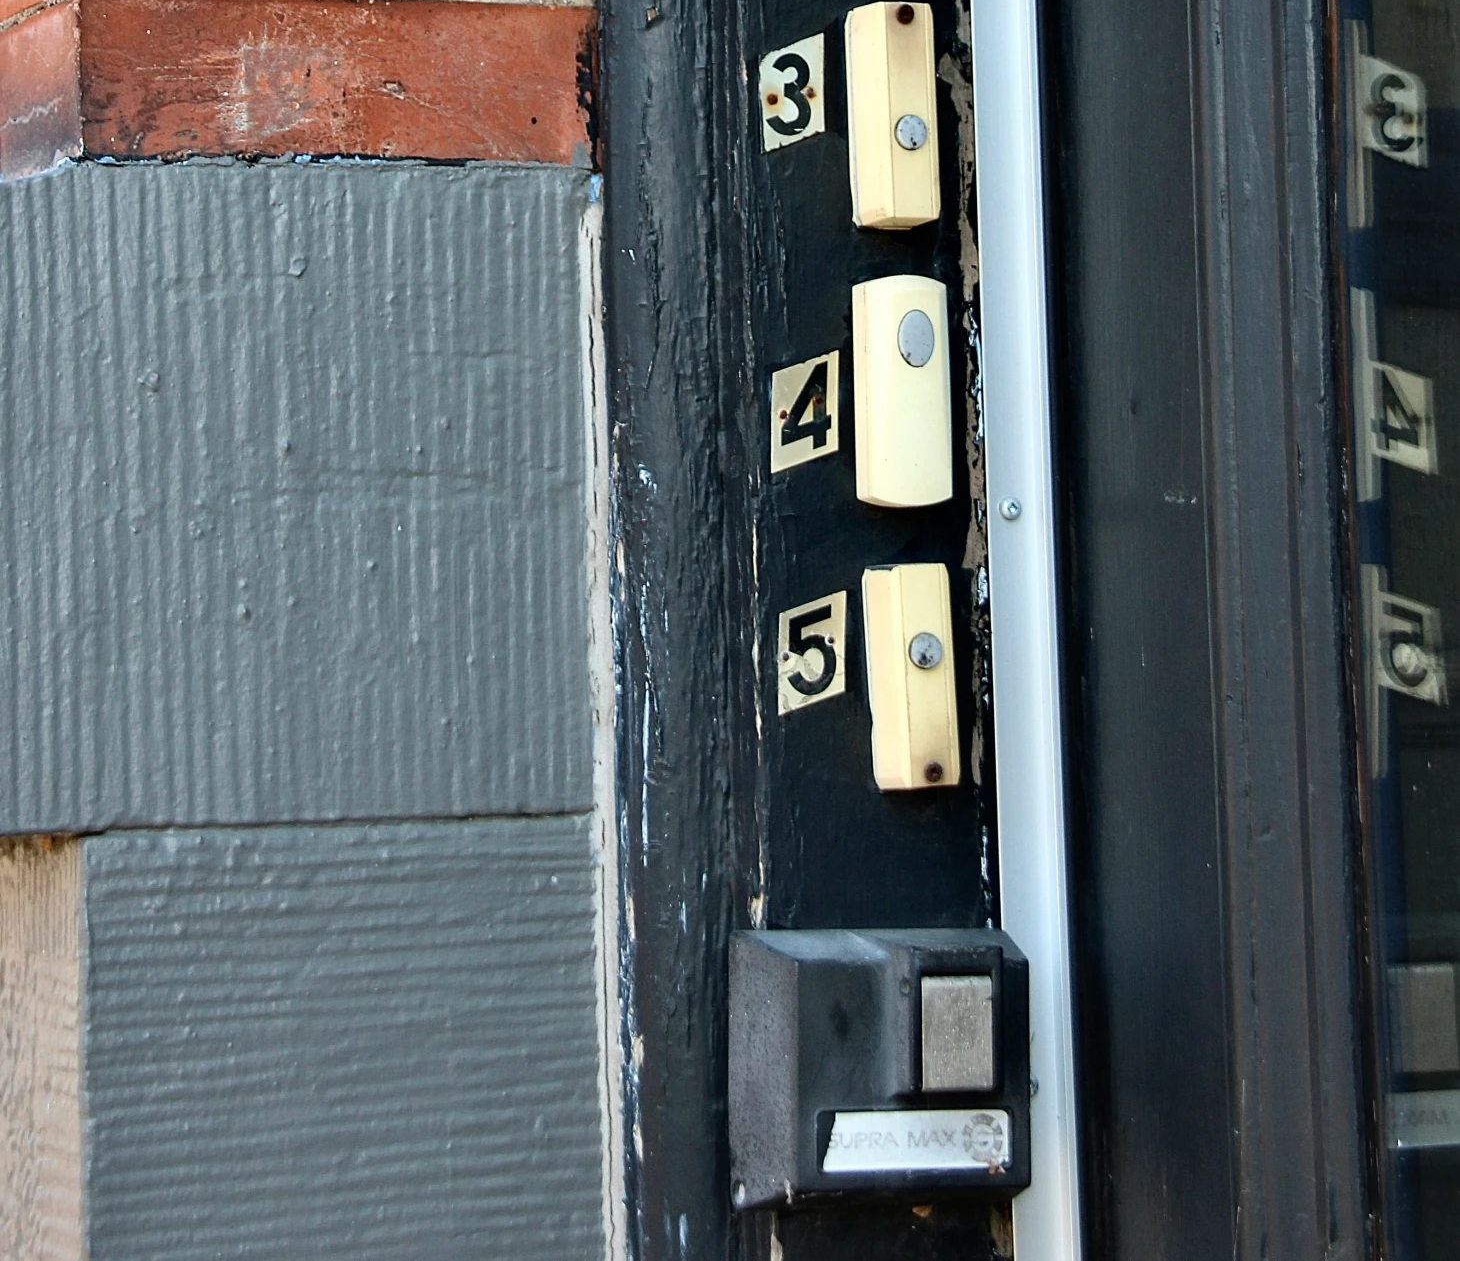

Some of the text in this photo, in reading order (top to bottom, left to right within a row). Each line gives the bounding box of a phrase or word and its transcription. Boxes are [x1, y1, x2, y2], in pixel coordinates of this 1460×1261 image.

[766, 53, 812, 135] 3
[781, 360, 831, 450] 4
[788, 604, 836, 696] 5
[907, 1128, 957, 1148] MAX
